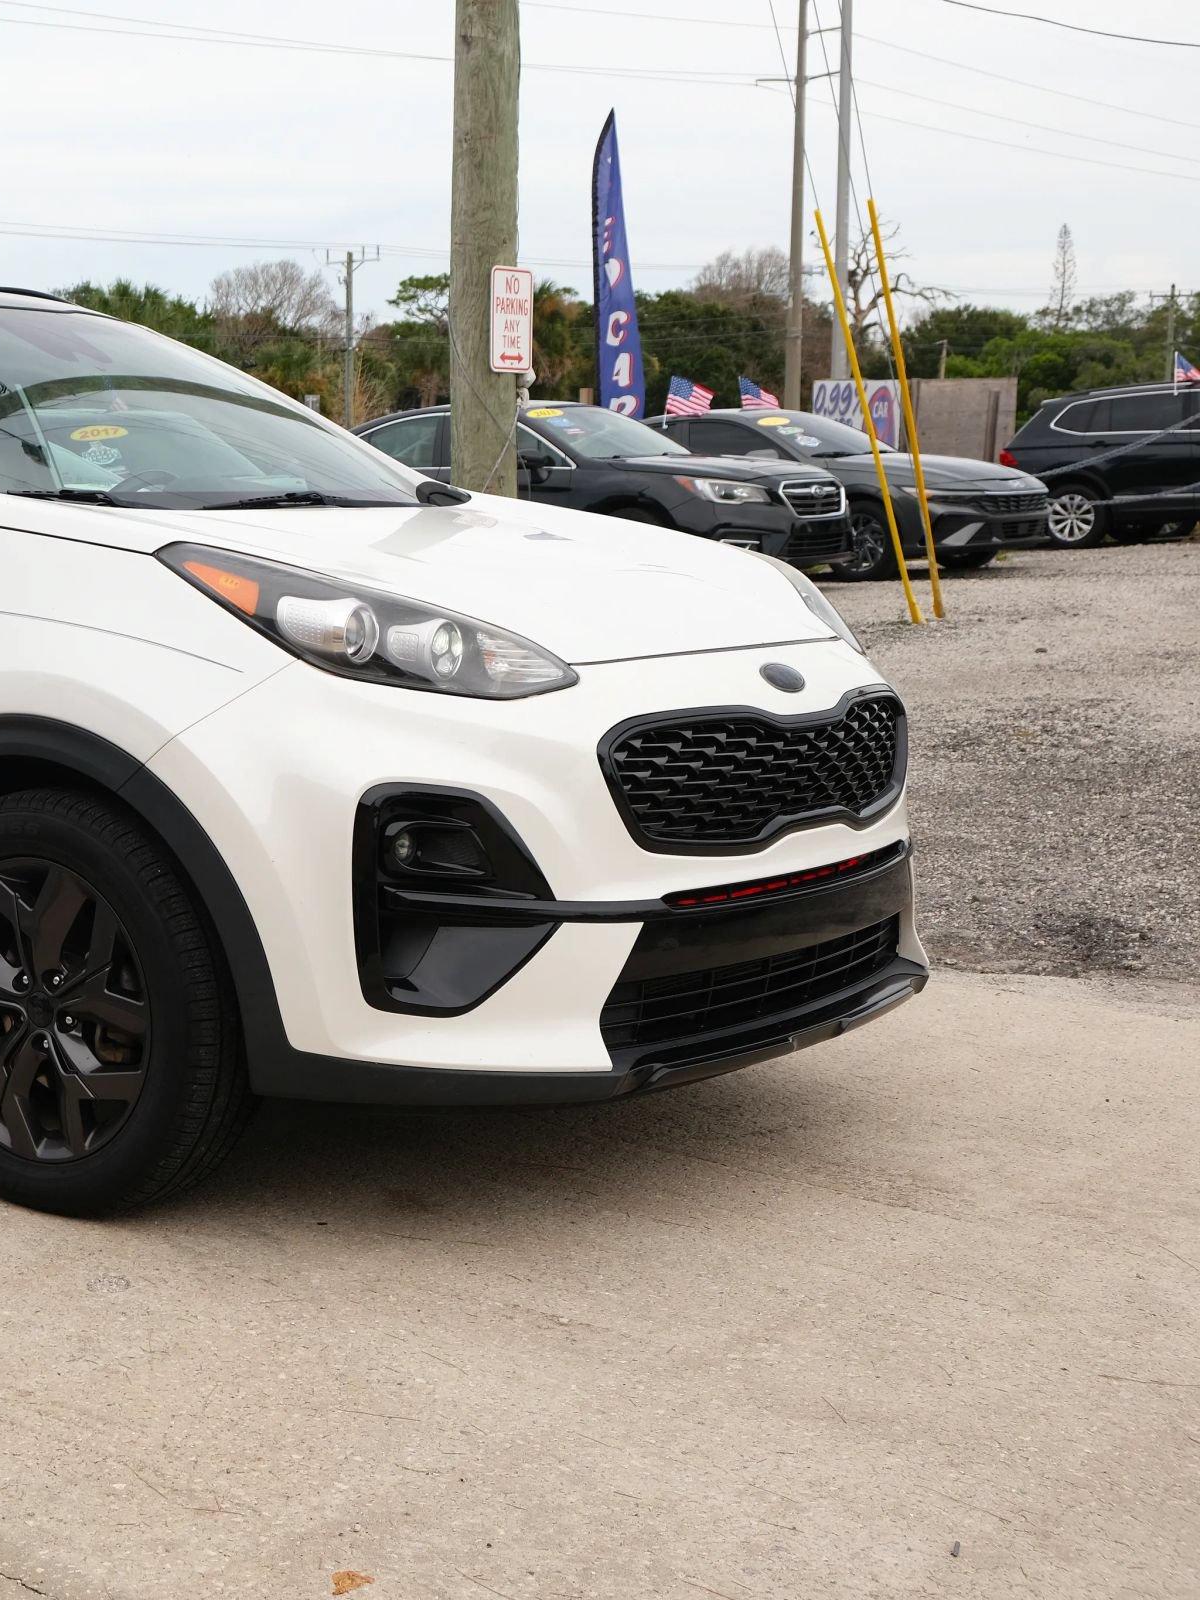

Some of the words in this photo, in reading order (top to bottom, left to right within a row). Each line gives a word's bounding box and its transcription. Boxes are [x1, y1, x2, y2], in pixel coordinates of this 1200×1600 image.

[505, 276, 520, 294] NO
[496, 297, 528, 316] PARKING
[504, 320, 520, 333] ANY
[503, 335, 521, 349] TIME
[873, 400, 889, 418] CAR
[79, 427, 121, 439] 2017
